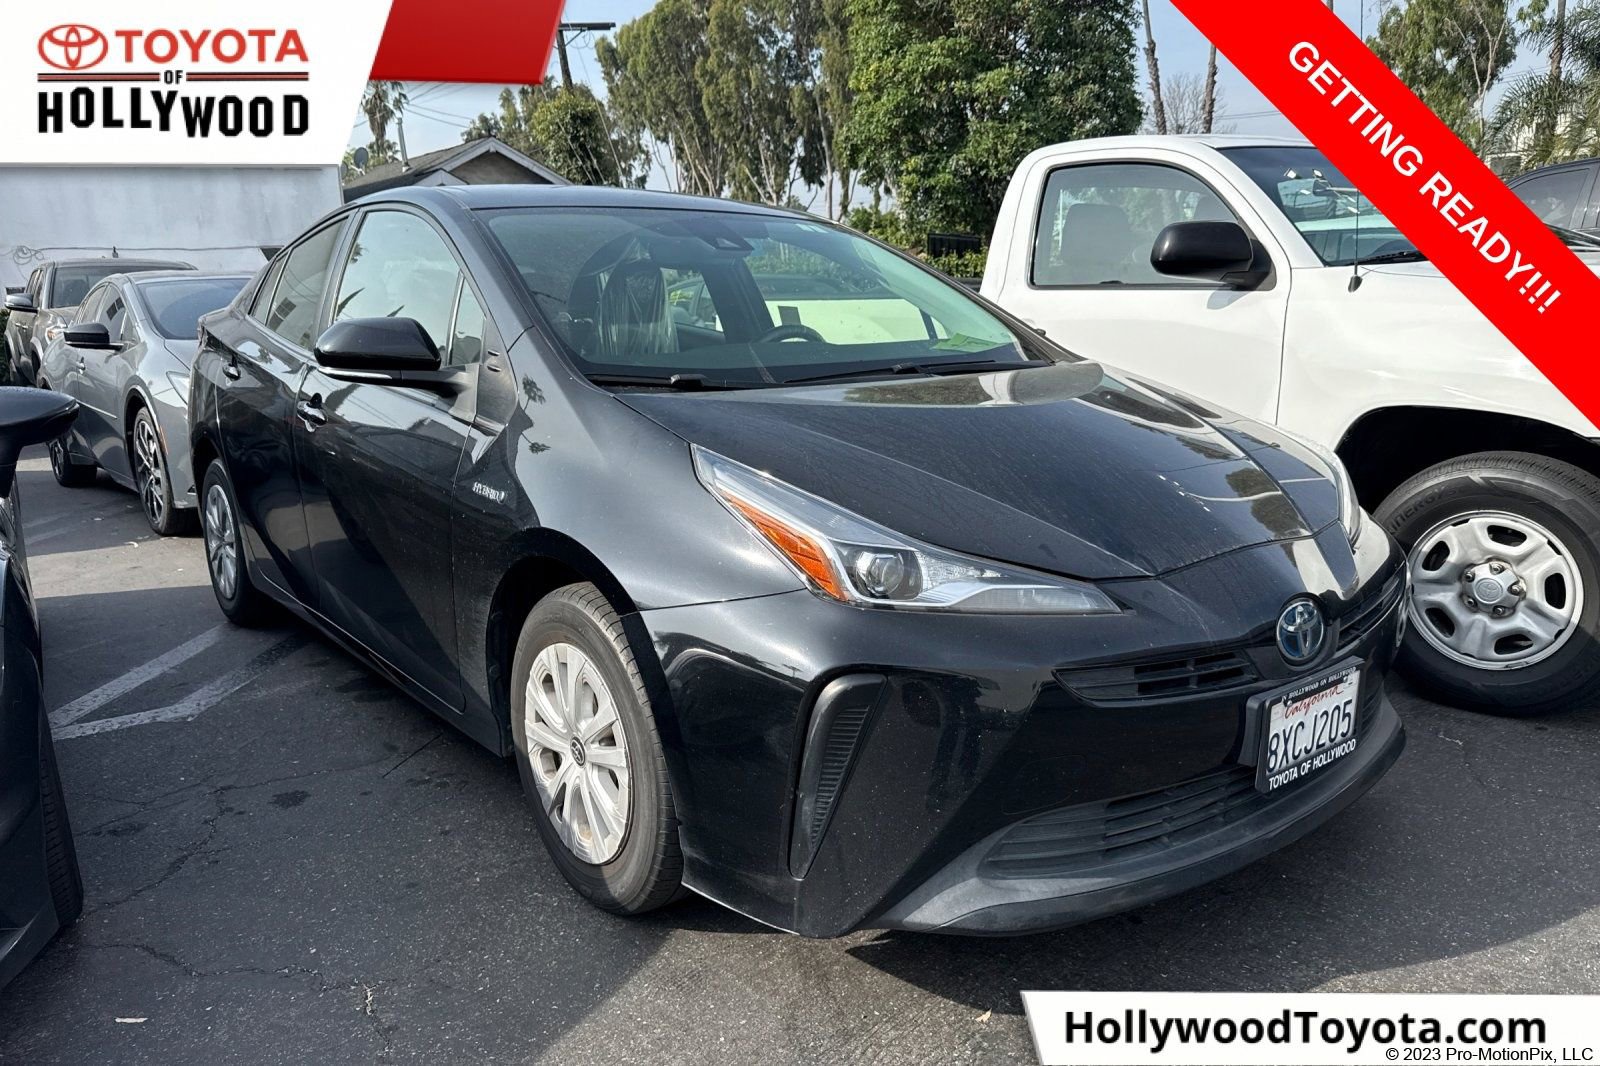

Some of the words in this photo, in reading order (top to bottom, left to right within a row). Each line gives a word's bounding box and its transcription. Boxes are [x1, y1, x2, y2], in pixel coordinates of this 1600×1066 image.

[1284, 684, 1344, 719] California
[1267, 699, 1353, 774] 8XCJ205
[1268, 768, 1298, 791] TOYOTA
[1300, 760, 1311, 775] OF
[1312, 738, 1357, 770] HOLLYWOOD
